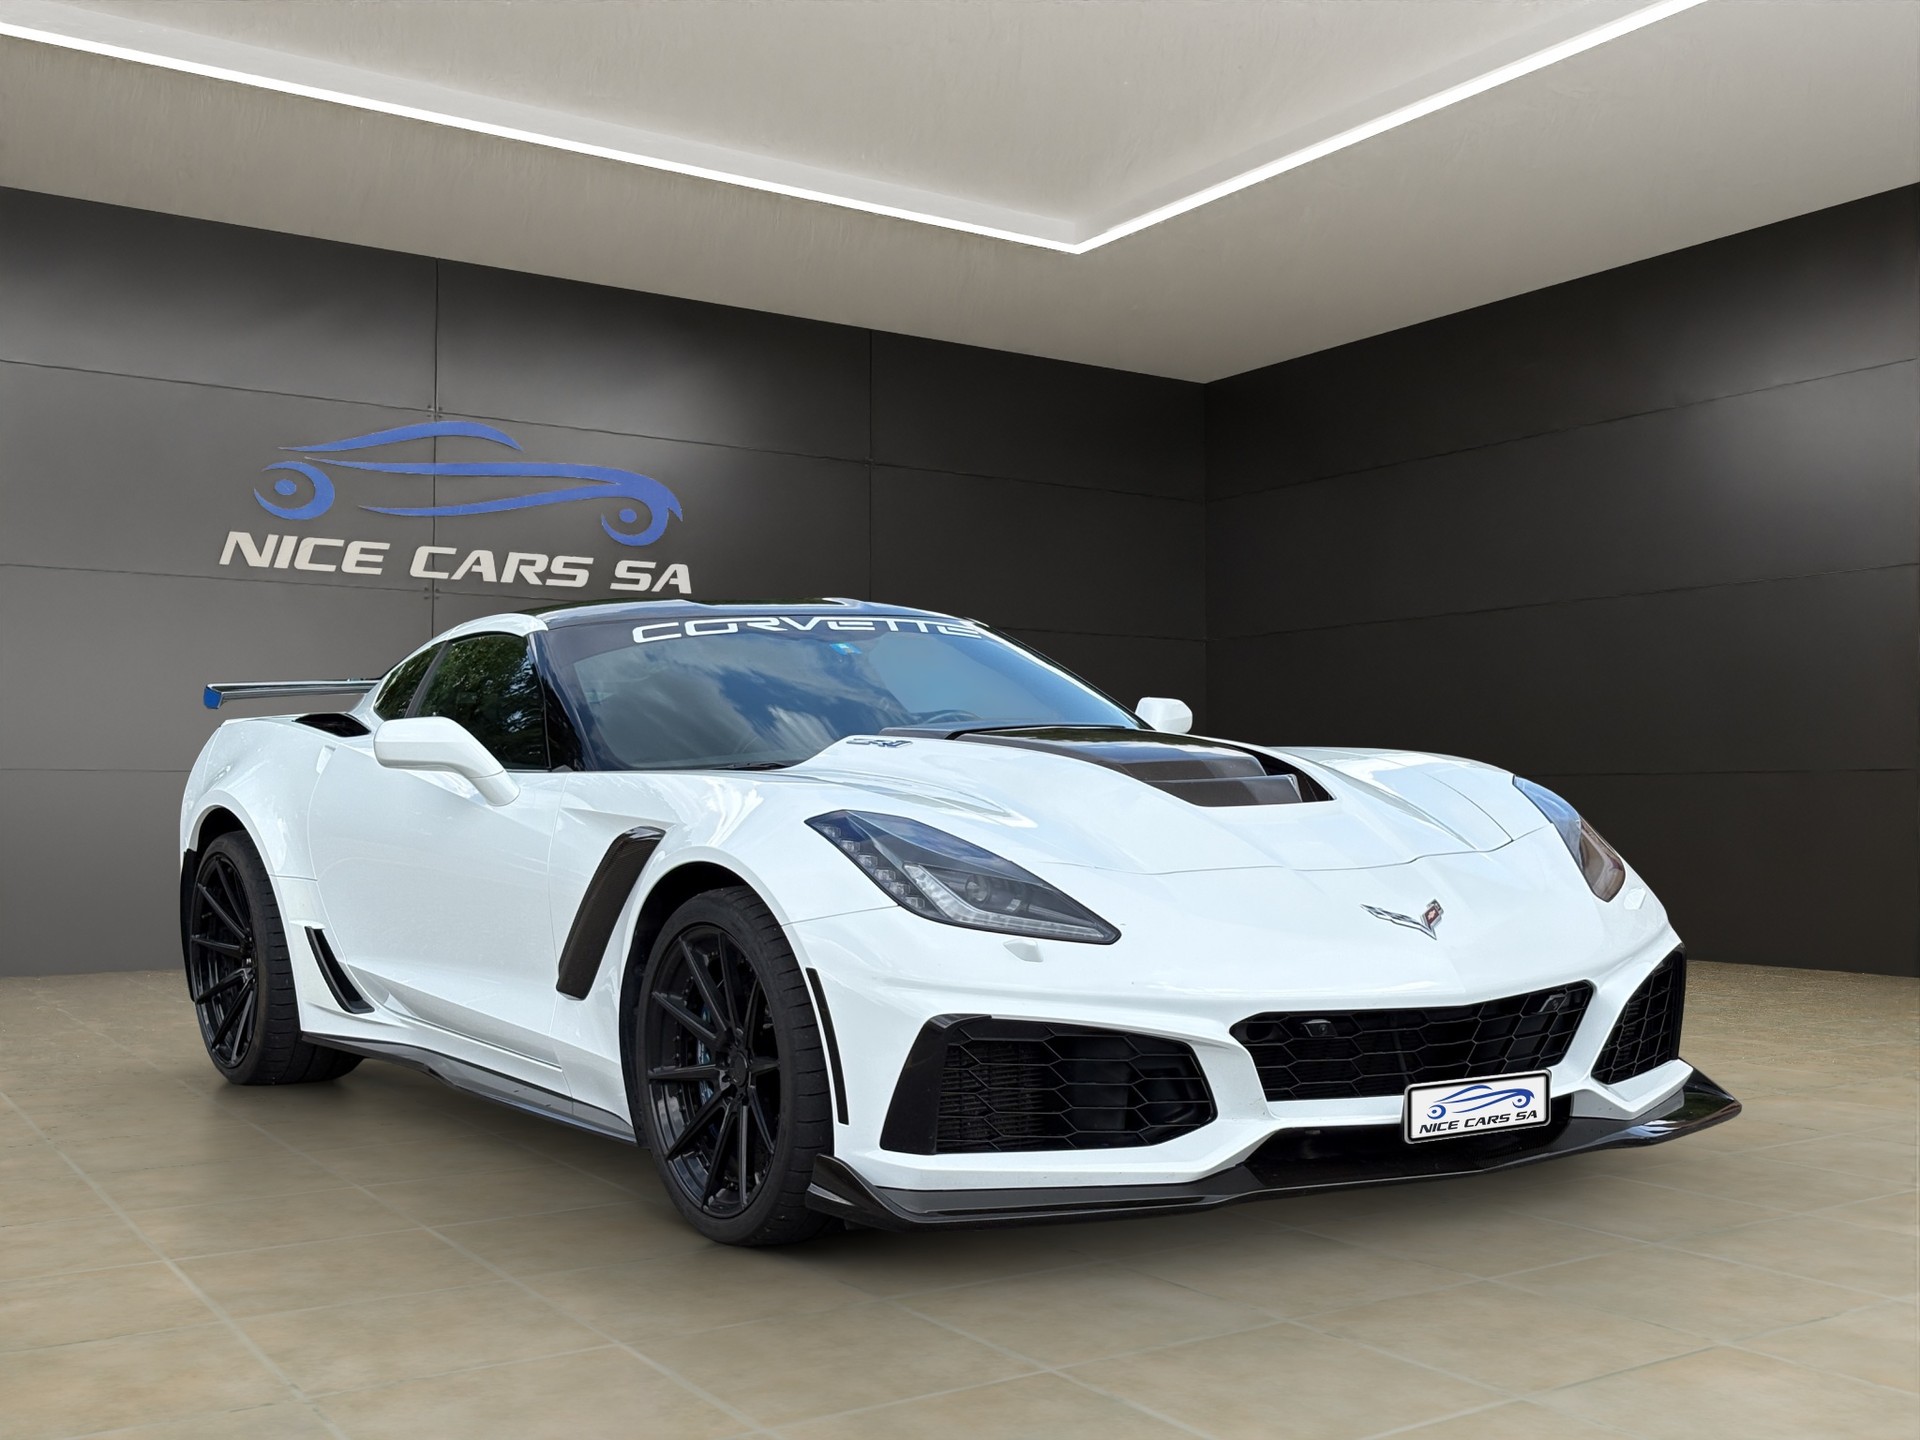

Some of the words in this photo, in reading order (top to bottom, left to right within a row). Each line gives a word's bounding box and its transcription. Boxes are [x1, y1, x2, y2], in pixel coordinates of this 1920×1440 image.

[219, 531, 391, 576] NICE
[409, 545, 594, 588] CARS
[609, 559, 693, 594] SA
[632, 616, 982, 643] CORVETTE
[1419, 1120, 1459, 1133] NICE
[1464, 1114, 1511, 1128] CARS
[1515, 1110, 1538, 1121] SA
